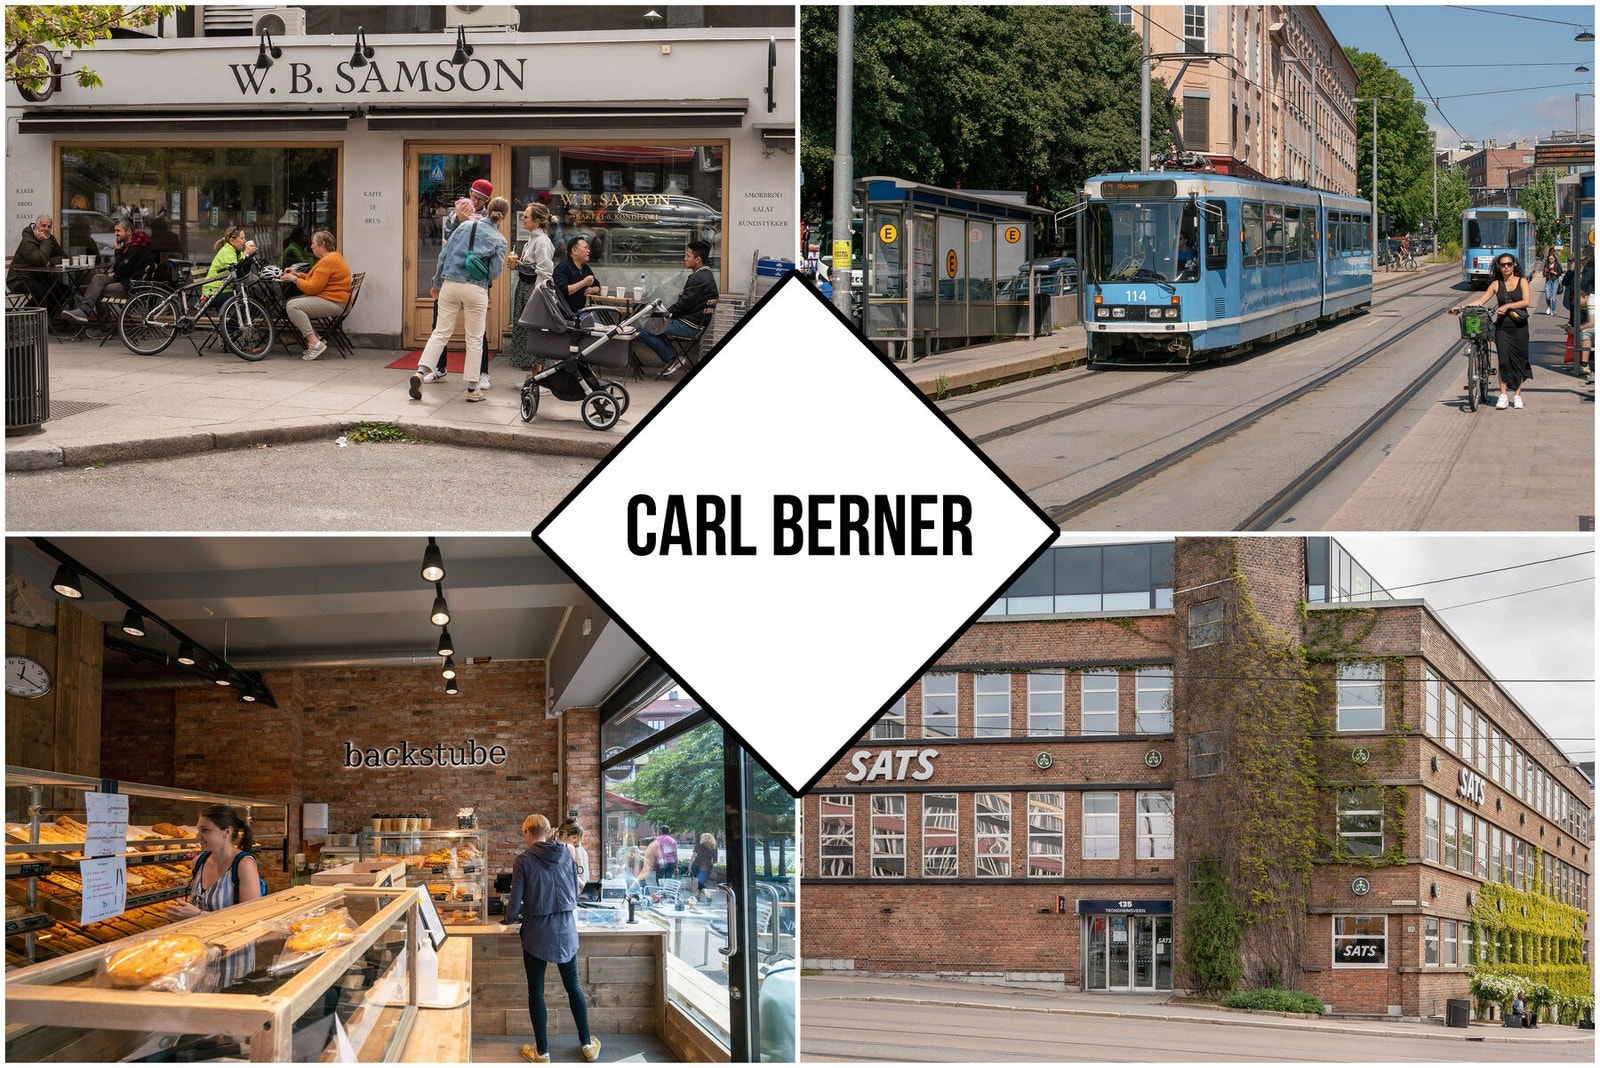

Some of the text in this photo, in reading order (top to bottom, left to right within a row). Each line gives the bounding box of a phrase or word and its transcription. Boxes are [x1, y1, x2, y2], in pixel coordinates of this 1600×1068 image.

[229, 57, 527, 95] W. B. SAMSON
[582, 193, 596, 207] B.
[600, 192, 671, 207] SAMSON
[575, 212, 605, 221] BAKERI
[614, 212, 660, 221] KONDITORI
[752, 205, 775, 213] SALAT
[1125, 289, 1148, 303] 114
[342, 739, 508, 773] backstube
[845, 748, 940, 783] SATS
[1456, 766, 1487, 807] SATS
[1118, 900, 1133, 908] 135
[1342, 944, 1378, 959] SATS
